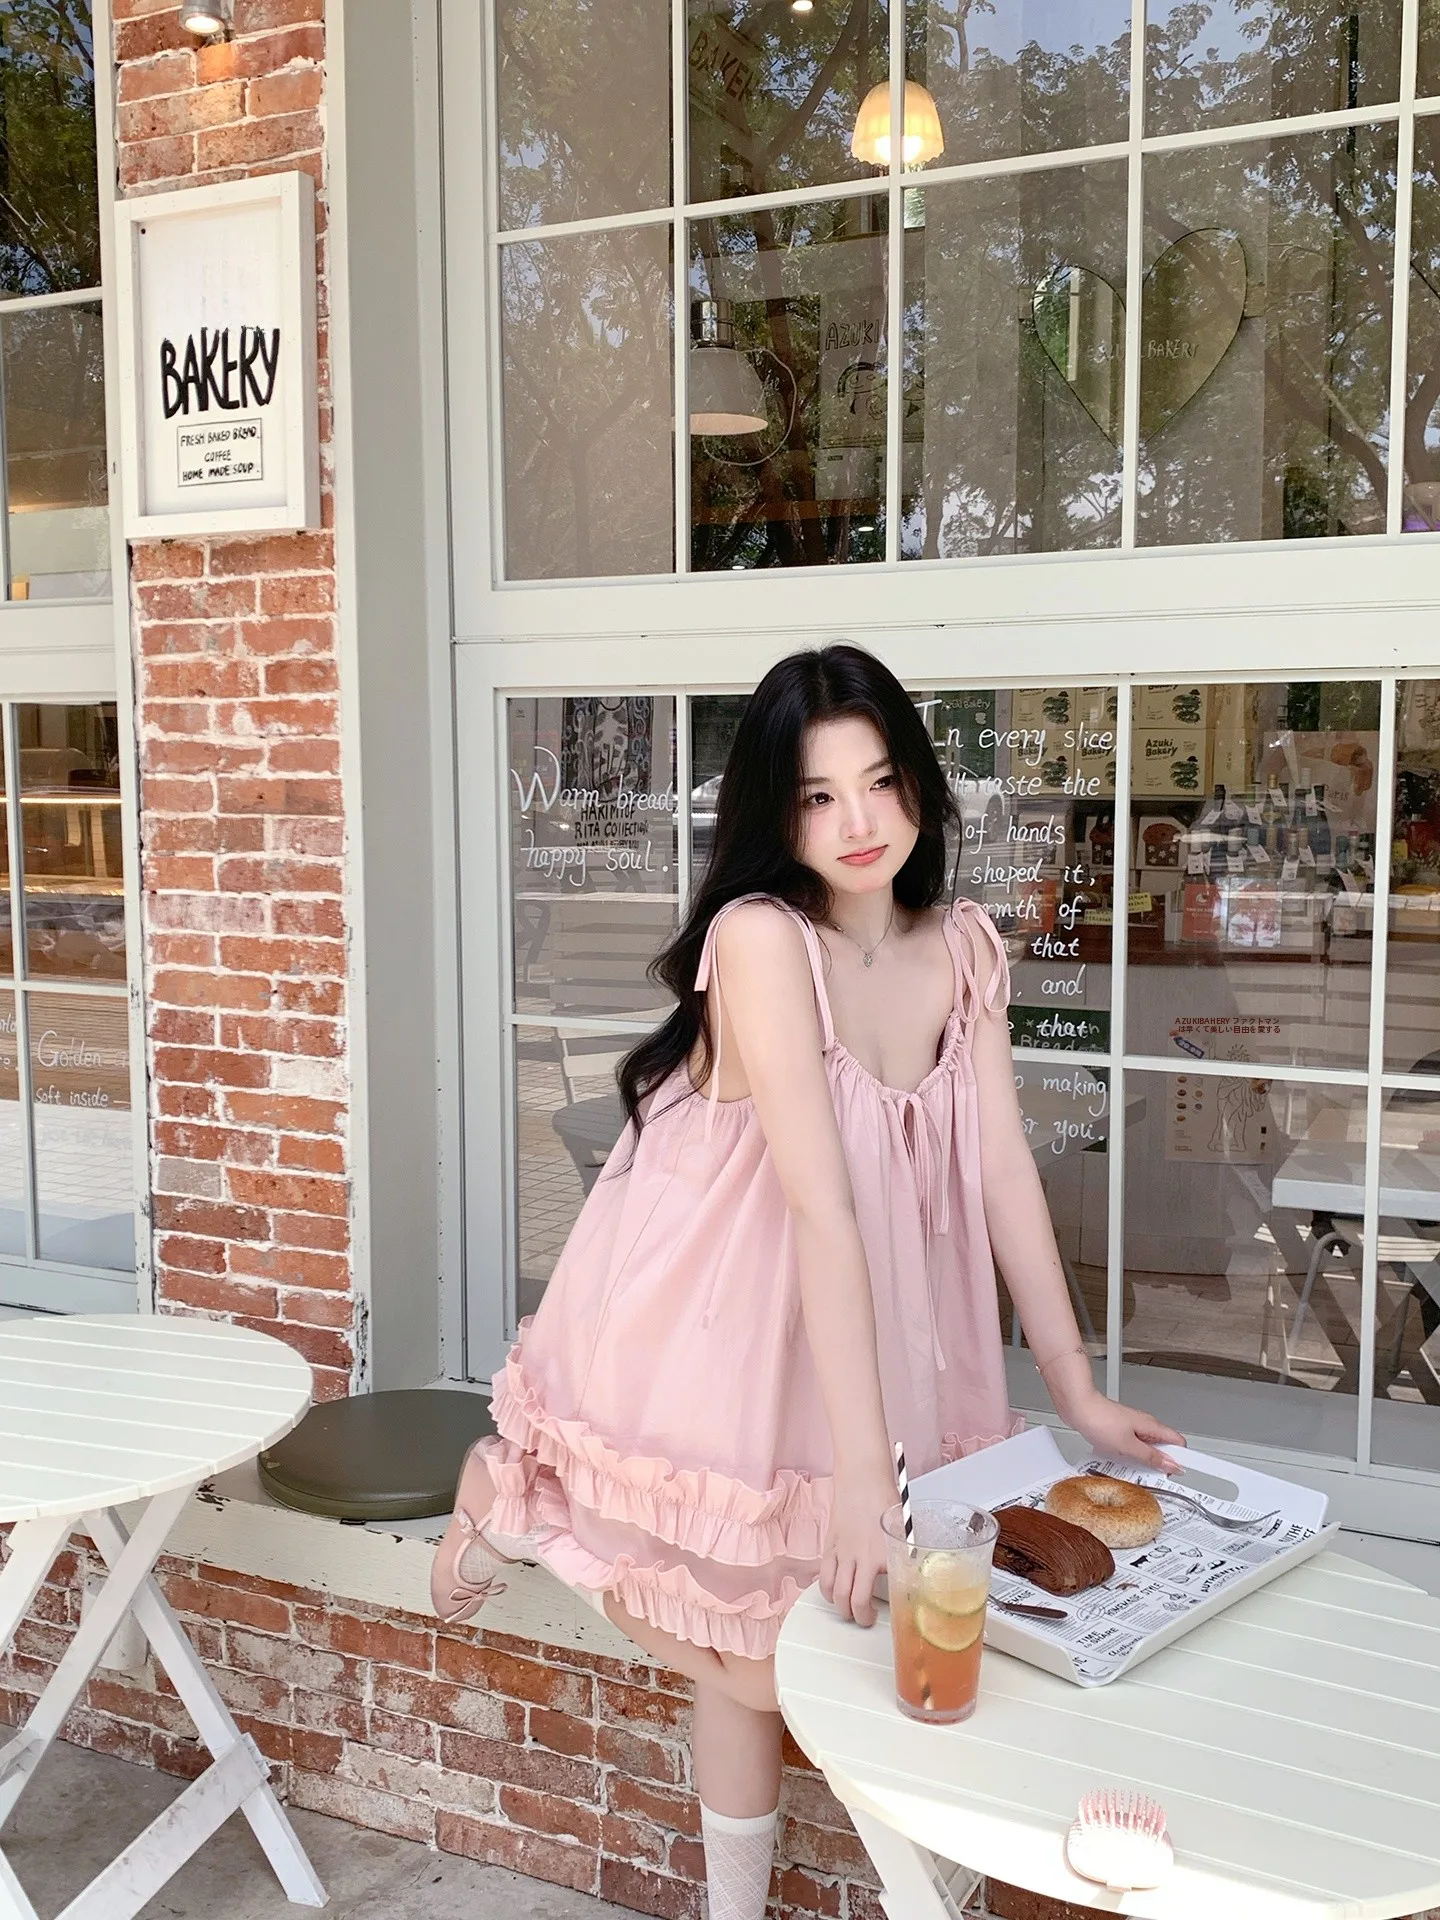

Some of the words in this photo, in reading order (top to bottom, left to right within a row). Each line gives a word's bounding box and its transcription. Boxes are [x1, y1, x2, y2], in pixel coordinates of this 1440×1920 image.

[825, 319, 880, 351] AZUKI
[160, 325, 280, 419] BAKERY
[180, 433, 205, 447] FRESH
[207, 430, 231, 443] BAKED
[204, 449, 231, 462] COFFEE
[182, 468, 203, 481] HOME
[208, 465, 230, 477] MADE
[978, 728, 1046, 767] every
[1063, 721, 1117, 753] slice,
[1145, 738, 1174, 748] Azuki
[1145, 746, 1178, 757] Bakery
[510, 746, 603, 812] Warm
[1062, 769, 1101, 796] the
[574, 821, 600, 839] RITA
[965, 814, 988, 854] of
[1006, 815, 1066, 845] hands
[526, 829, 587, 887] happy
[970, 856, 1043, 894] shaped
[1064, 864, 1096, 886] it,
[1059, 895, 1083, 930] of
[1030, 933, 1080, 958] that
[1041, 964, 1087, 996] and
[1036, 1013, 1088, 1038] that
[38, 1030, 101, 1067] Golden
[70, 1086, 110, 1107] inside
[1043, 1071, 1106, 1117] making
[1076, 1630, 1101, 1644] TIME
